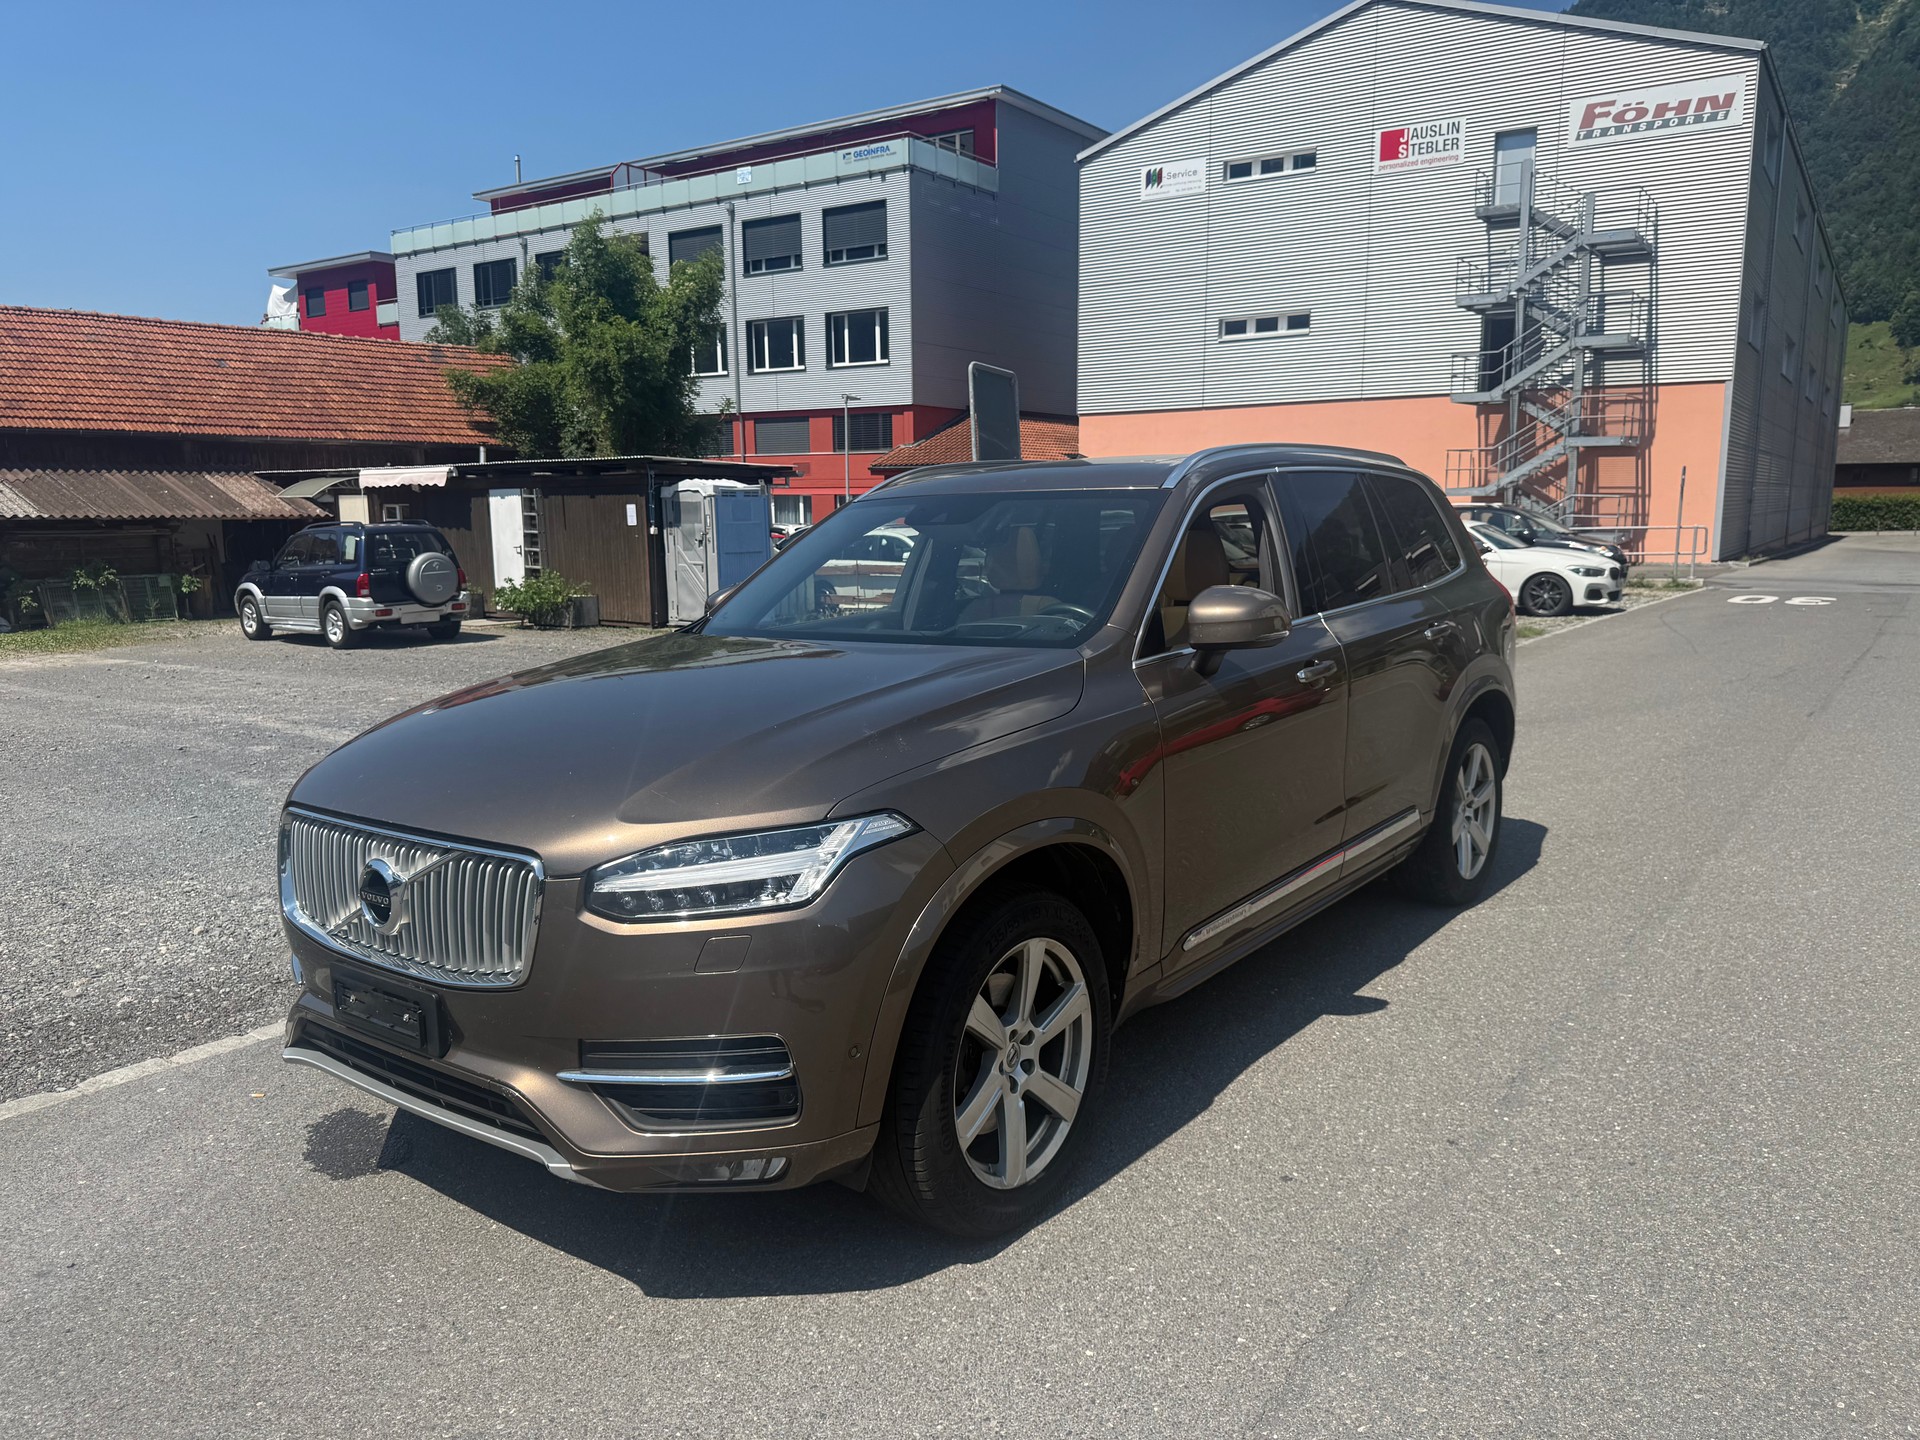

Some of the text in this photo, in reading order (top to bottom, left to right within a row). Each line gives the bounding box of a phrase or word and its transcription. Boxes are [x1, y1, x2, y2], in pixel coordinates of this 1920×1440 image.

[1400, 121, 1460, 143] JAUSLIN
[1578, 110, 1727, 140] TRANSPORTE
[853, 145, 890, 158] GEOINFRA
[1398, 137, 1460, 158] STEBLER
[1378, 154, 1459, 171] personalized engineering
[361, 891, 389, 905] VOLVO
